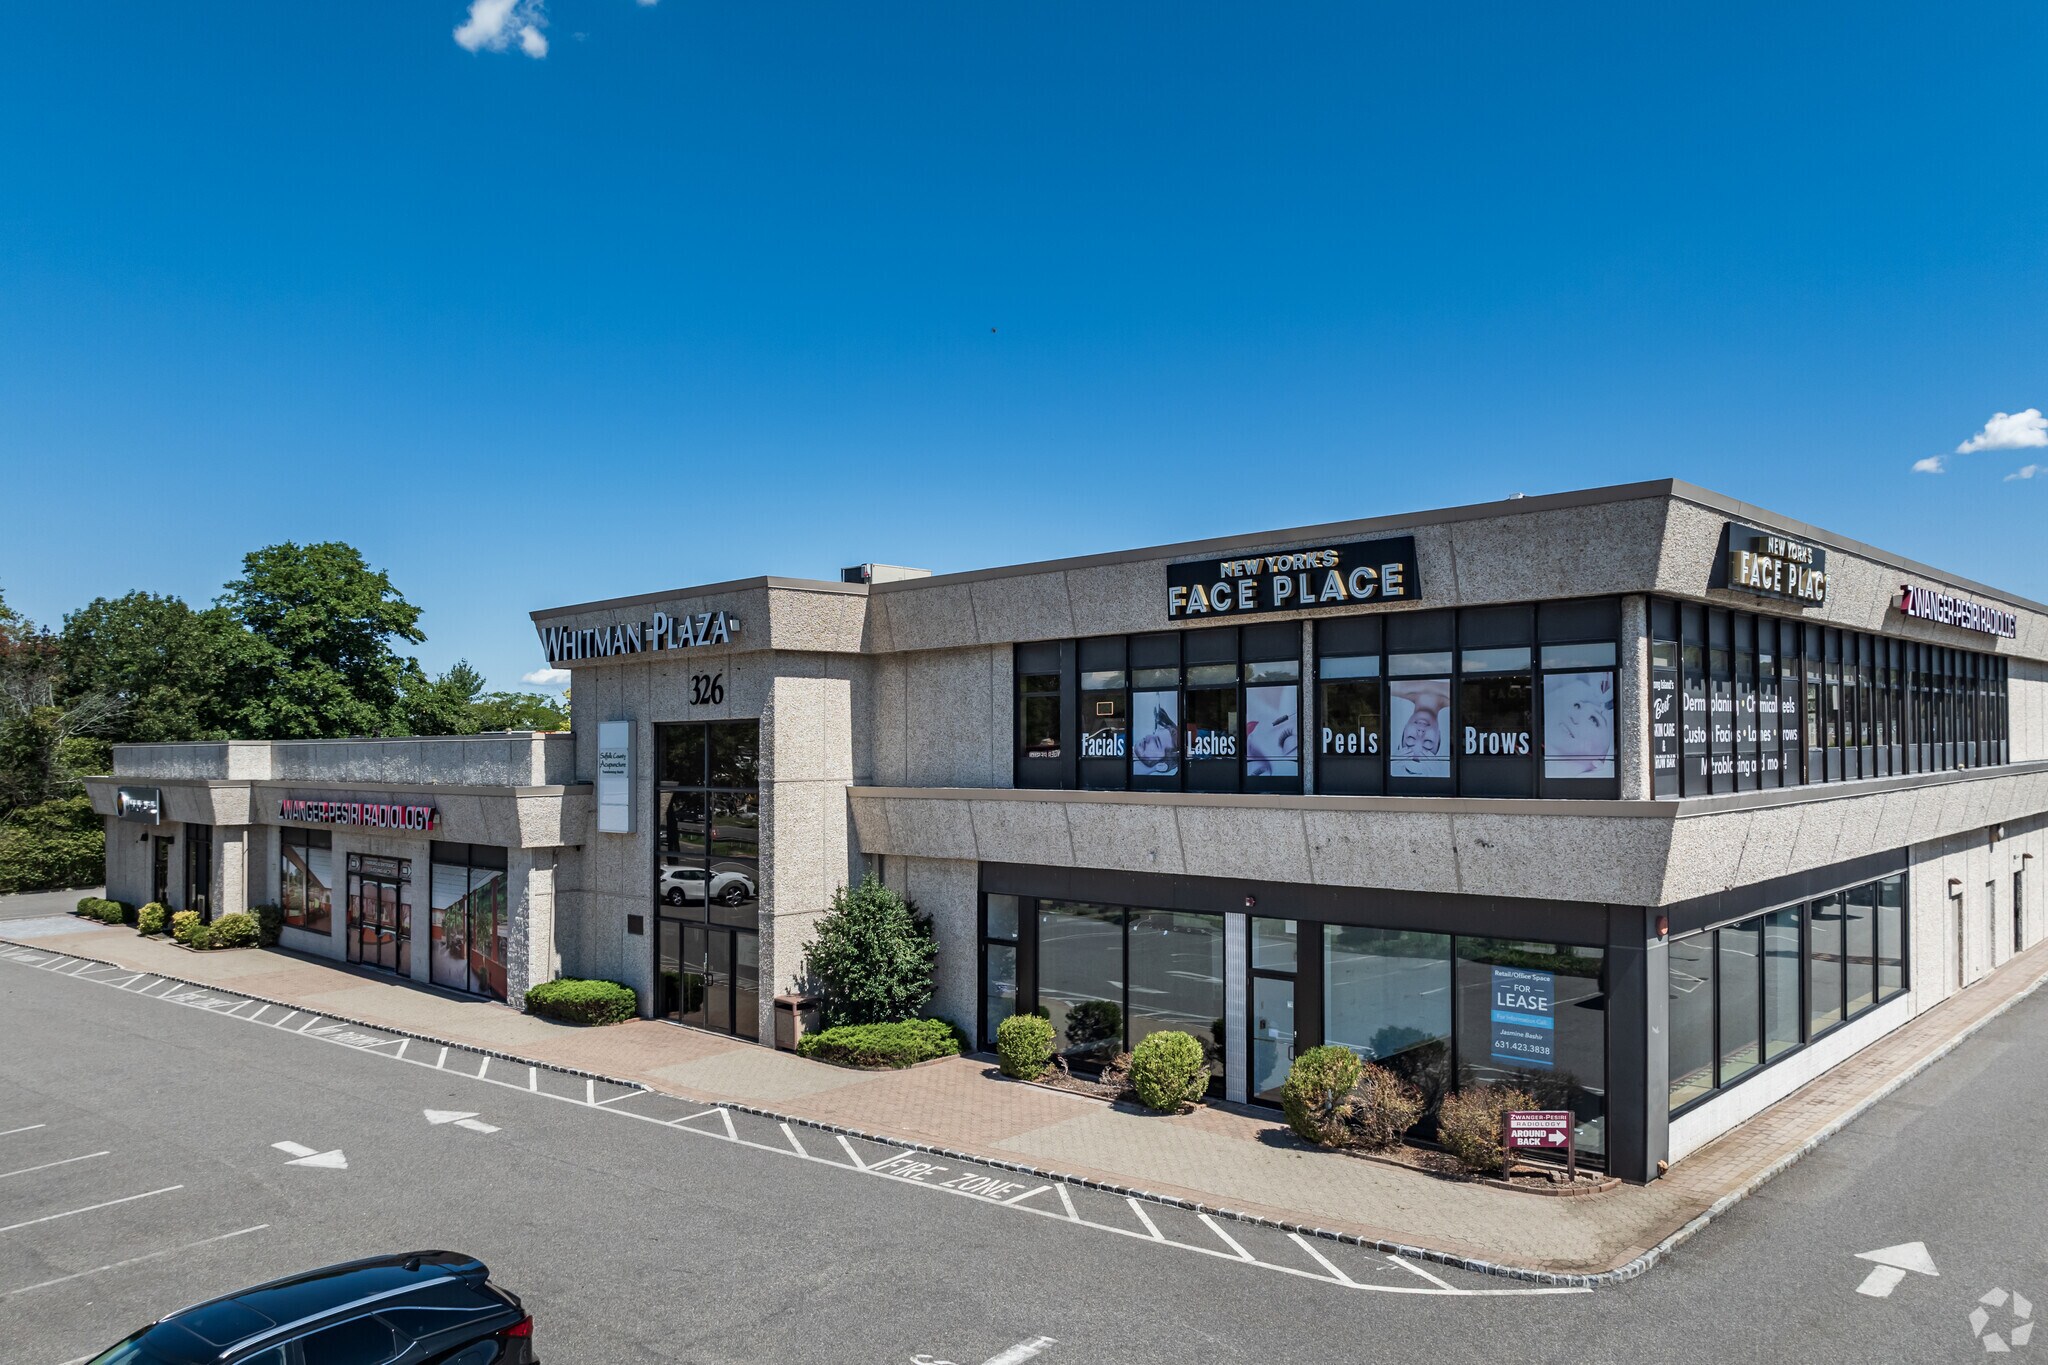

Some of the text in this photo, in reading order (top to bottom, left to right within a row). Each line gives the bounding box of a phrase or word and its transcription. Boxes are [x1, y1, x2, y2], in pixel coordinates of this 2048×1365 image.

[1221, 549, 1340, 578] NEW YORK'S
[1768, 537, 1813, 565] NEW YORK'S
[1169, 562, 1406, 616] FACE PLACE
[1740, 550, 1832, 603] FACE PLACE
[1907, 585, 2017, 639] ZWANGER-PESIRI RADIOLOGY
[541, 611, 731, 663] WHITMAN PLAZA
[690, 674, 724, 706] 326
[1653, 694, 1673, 720] Best
[1746, 694, 1778, 714] Chmical
[1782, 696, 1795, 714] eels
[1082, 726, 1530, 758] Facials Lashes Peels Brows
[1683, 724, 1798, 744] Custo Facis Laes rows
[1751, 753, 1766, 773] ad
[278, 799, 433, 831] ZWANGER-PESIRI RADIOLOGY
[1494, 970, 1551, 984] Retail/Office Space
[1514, 984, 1531, 993] FOR
[1497, 992, 1548, 1011] LEASE
[1500, 1029, 1524, 1038] Jasmine
[1494, 1040, 1551, 1056] 631.423.3838
[1511, 1130, 1547, 1138] AROUND
[1517, 1138, 1542, 1146] BACK
[875, 1158, 1026, 1199] FIRE ZONE
